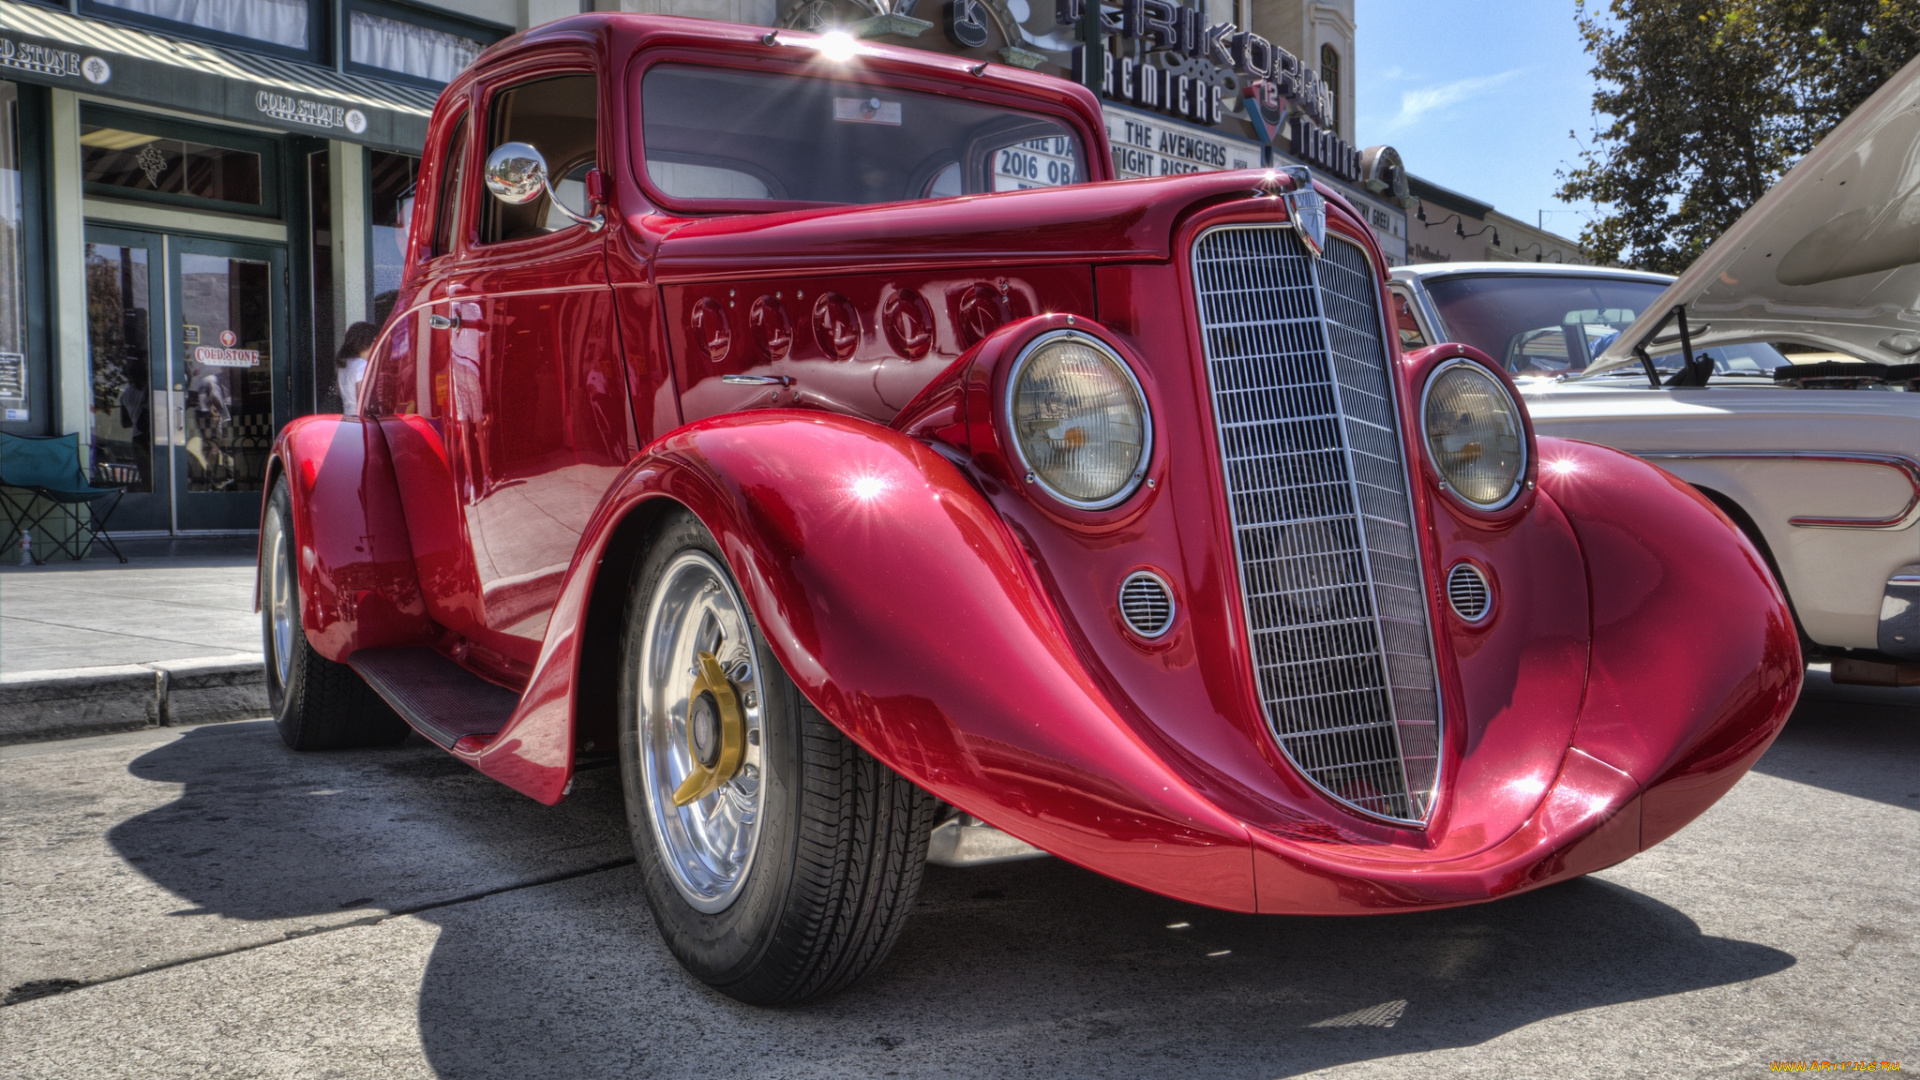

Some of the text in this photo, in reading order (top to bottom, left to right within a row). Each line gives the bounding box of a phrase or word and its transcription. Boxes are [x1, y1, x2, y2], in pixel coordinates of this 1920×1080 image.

[17, 42, 81, 76] STONE
[256, 91, 345, 127] COLD STONE
[1260, 80, 1278, 107] 12
[1125, 121, 1227, 167] THE AVENGERS
[1299, 118, 1363, 182] THEATRES
[1002, 150, 1038, 180] 2016
[196, 347, 225, 362] COLD
[226, 349, 259, 365] STONE
[750, 819, 778, 919] LOW NOISE
